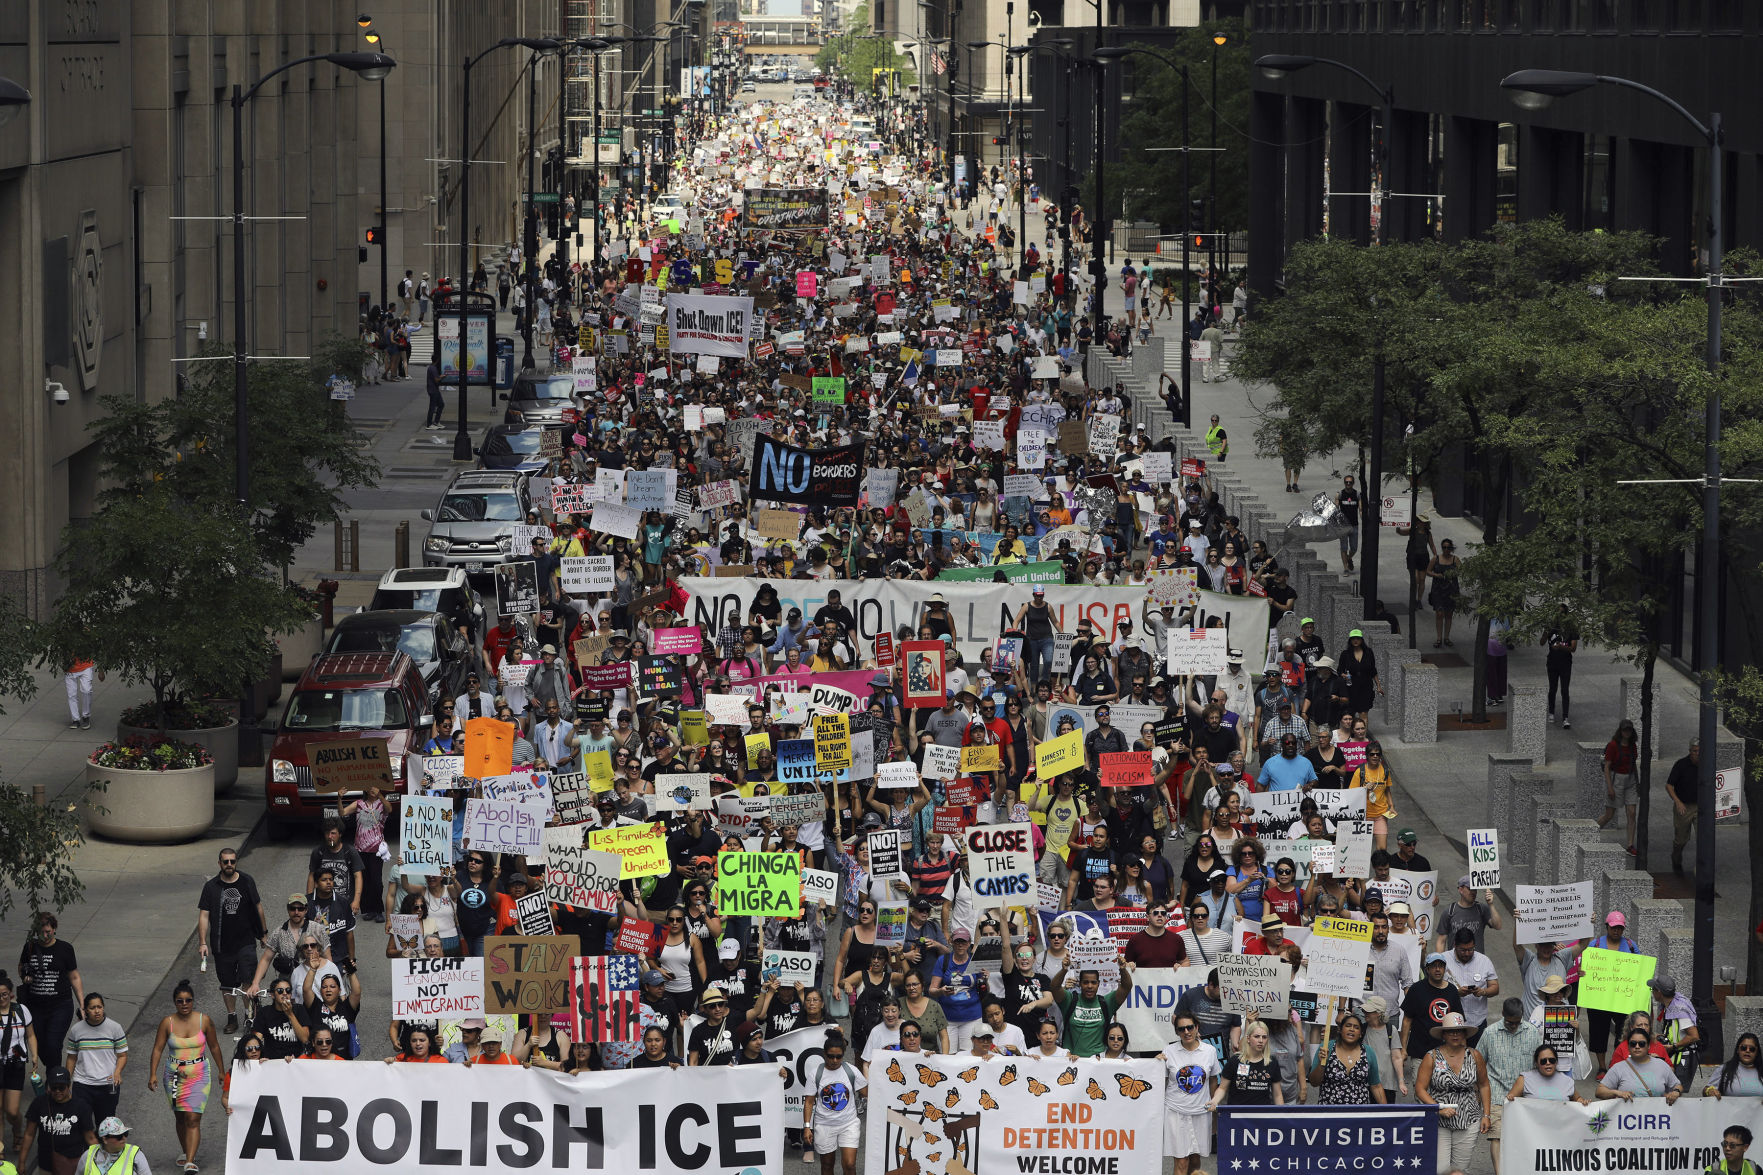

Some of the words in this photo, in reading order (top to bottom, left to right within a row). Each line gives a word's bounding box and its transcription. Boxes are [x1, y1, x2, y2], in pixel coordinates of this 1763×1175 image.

[676, 307, 697, 330] Shut
[699, 309, 724, 333] Down
[726, 311, 743, 334] ICE!
[760, 442, 811, 494] NO
[813, 463, 857, 478] BORDERS
[562, 487, 571, 495] NO
[633, 483, 656, 492] Dream
[556, 496, 577, 504] HUMAN
[593, 565, 612, 573] BORDER
[1009, 572, 1027, 582] and
[1030, 570, 1060, 582] United
[585, 666, 614, 675] Together
[588, 673, 604, 682] Fight
[617, 672, 627, 680] All
[644, 666, 672, 675] HUMAN
[813, 688, 851, 713] DUMP
[821, 715, 839, 724] FREE
[937, 719, 959, 728] RESIST
[816, 724, 831, 733] ALL
[832, 723, 845, 732] THE
[816, 731, 846, 742] CHILDREN!
[818, 744, 829, 753] FULL
[830, 742, 847, 752] RIGHTS
[967, 748, 985, 757] END
[315, 747, 357, 765] ABOLISH
[360, 745, 379, 760] ICE
[822, 752, 832, 761] FOR
[833, 751, 844, 760] ALL!
[1041, 748, 1066, 763] AMNESTY
[1042, 756, 1066, 768] INTERNATIONAL
[1103, 753, 1152, 764] NATIONALISM
[336, 764, 366, 772] HUMAN
[427, 758, 458, 770] CLOSE
[937, 766, 954, 774] there
[550, 773, 584, 793] KEEP
[660, 775, 708, 787] DREAMERS
[1109, 772, 1145, 782] RACISM
[949, 786, 972, 795] FAMILIES
[769, 793, 824, 805] FAMILIAS
[418, 806, 436, 821] NO
[769, 802, 819, 813] MERECEN
[770, 809, 805, 820] ESTAR
[475, 803, 535, 827] Abolish
[719, 814, 752, 827] STOP
[404, 821, 448, 841] HUMAN
[476, 822, 541, 846] ICE!!!
[1352, 821, 1373, 835] ICE
[616, 829, 655, 842] Familias
[871, 833, 897, 851] NO!
[968, 830, 1029, 854] CLOSE
[1471, 832, 1493, 847] ALL
[421, 840, 432, 849] IS
[475, 842, 485, 850] LA
[548, 843, 583, 859] WHAT
[403, 851, 450, 866] ILLEGAL
[1472, 848, 1497, 863] KIDS
[547, 857, 597, 877] WOULD
[625, 858, 665, 873] Unidas!!
[720, 854, 799, 877] CHINGA
[984, 855, 1016, 874] THE
[546, 865, 576, 887] YOU
[577, 873, 595, 890] DO
[596, 876, 619, 893] FOR
[746, 874, 769, 889] LA
[973, 873, 1031, 897] CAMPS
[1471, 869, 1500, 888] PARENTS
[544, 882, 573, 903] YOUR
[572, 886, 617, 912] FAMILY?
[1550, 886, 1569, 894] Name
[519, 893, 547, 916] ¡NO!
[720, 888, 794, 912] MIGRA
[1520, 897, 1543, 905] DAVID
[1553, 904, 1573, 912] Proud
[1517, 916, 1547, 924] Welcome
[1550, 911, 1587, 921] Immigrants
[1331, 921, 1368, 934] ICIRR
[1550, 921, 1580, 930] America!
[620, 934, 645, 945] BELONG
[622, 928, 650, 940] FAMILIES
[409, 957, 465, 974] FIGHT
[489, 943, 570, 975] STAY
[1218, 953, 1262, 966] DECENCY
[1310, 950, 1360, 967] Detention
[403, 969, 480, 985] IGNORANCE
[1219, 965, 1277, 977] COMPASSION
[417, 983, 449, 998] NOT
[1244, 979, 1265, 988] NOT
[1221, 986, 1281, 1003] PARTISAN
[1047, 1102, 1093, 1124] END
[1618, 1114, 1671, 1130] ICIRR
[239, 1095, 604, 1169] ABOLISH
[639, 1101, 767, 1170] ICE
[1003, 1127, 1135, 1151] DETENTION
[1230, 1127, 1424, 1146] INDIVISIBLE
[1016, 1155, 1119, 1175] WELCOME
[1269, 1156, 1384, 1170] CHICAGO
[1535, 1148, 1600, 1172] ILLINOIS
[1605, 1147, 1691, 1171] COALITION
[1693, 1146, 1721, 1171] FOR
